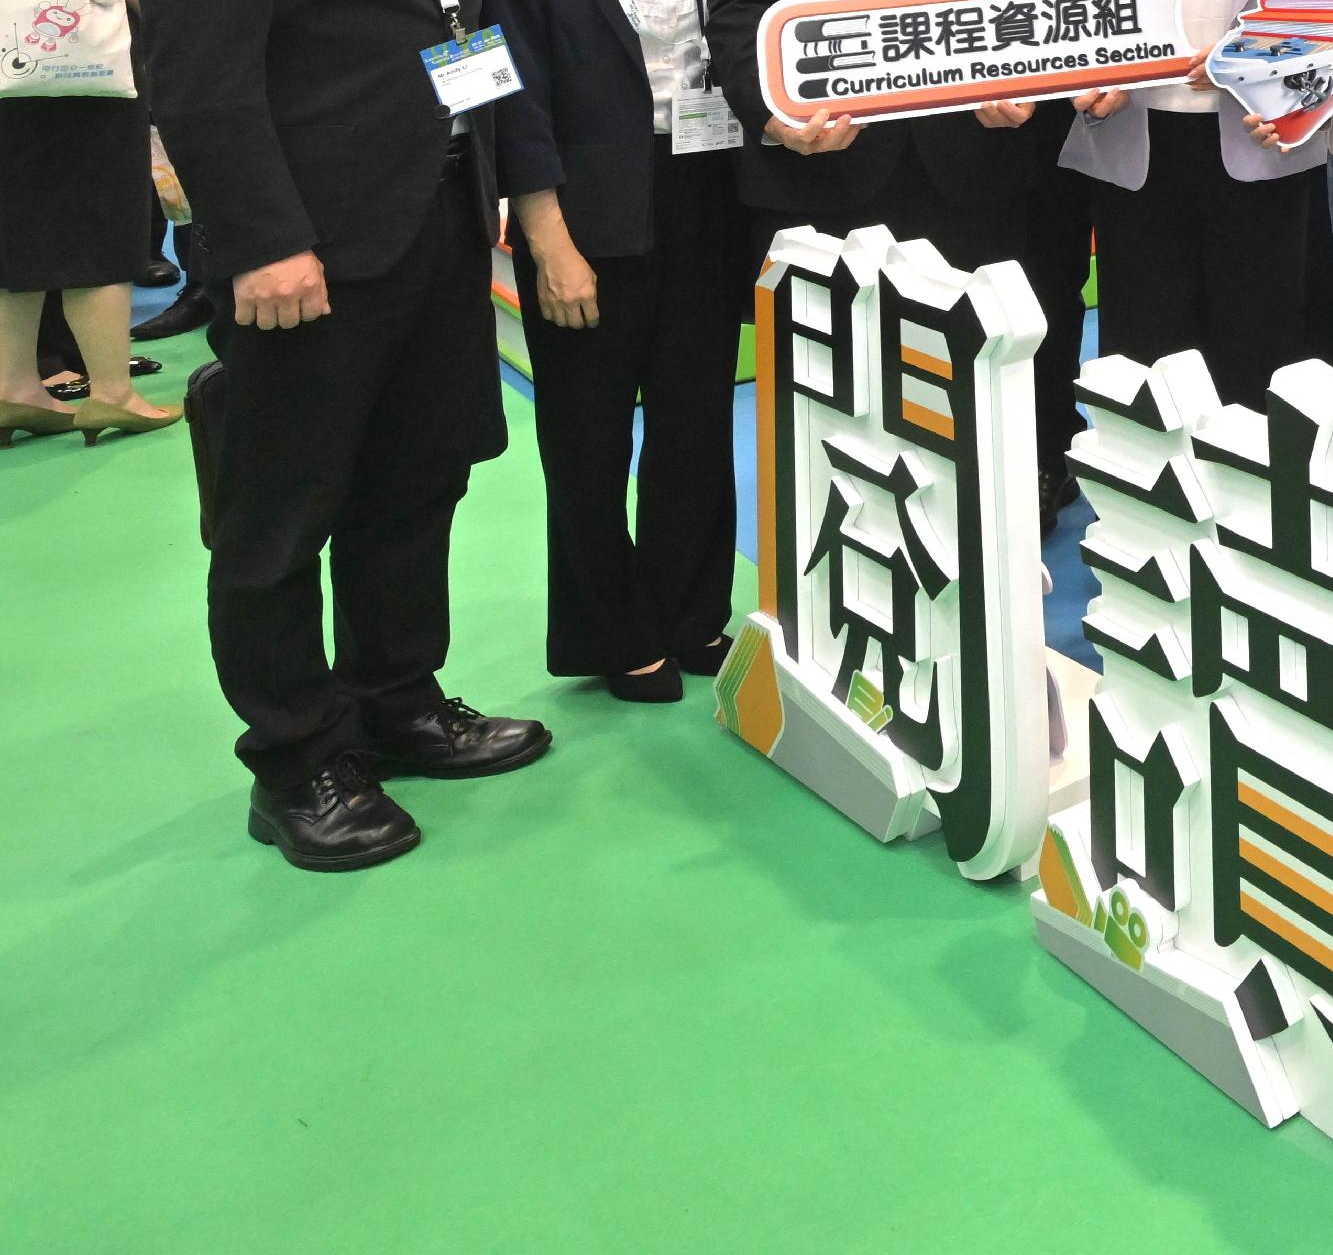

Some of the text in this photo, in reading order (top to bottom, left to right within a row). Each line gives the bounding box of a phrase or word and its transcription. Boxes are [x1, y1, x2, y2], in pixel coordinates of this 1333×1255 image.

[831, 41, 1176, 98] Curriculum Resources Section
[756, 255, 992, 864] 閱
